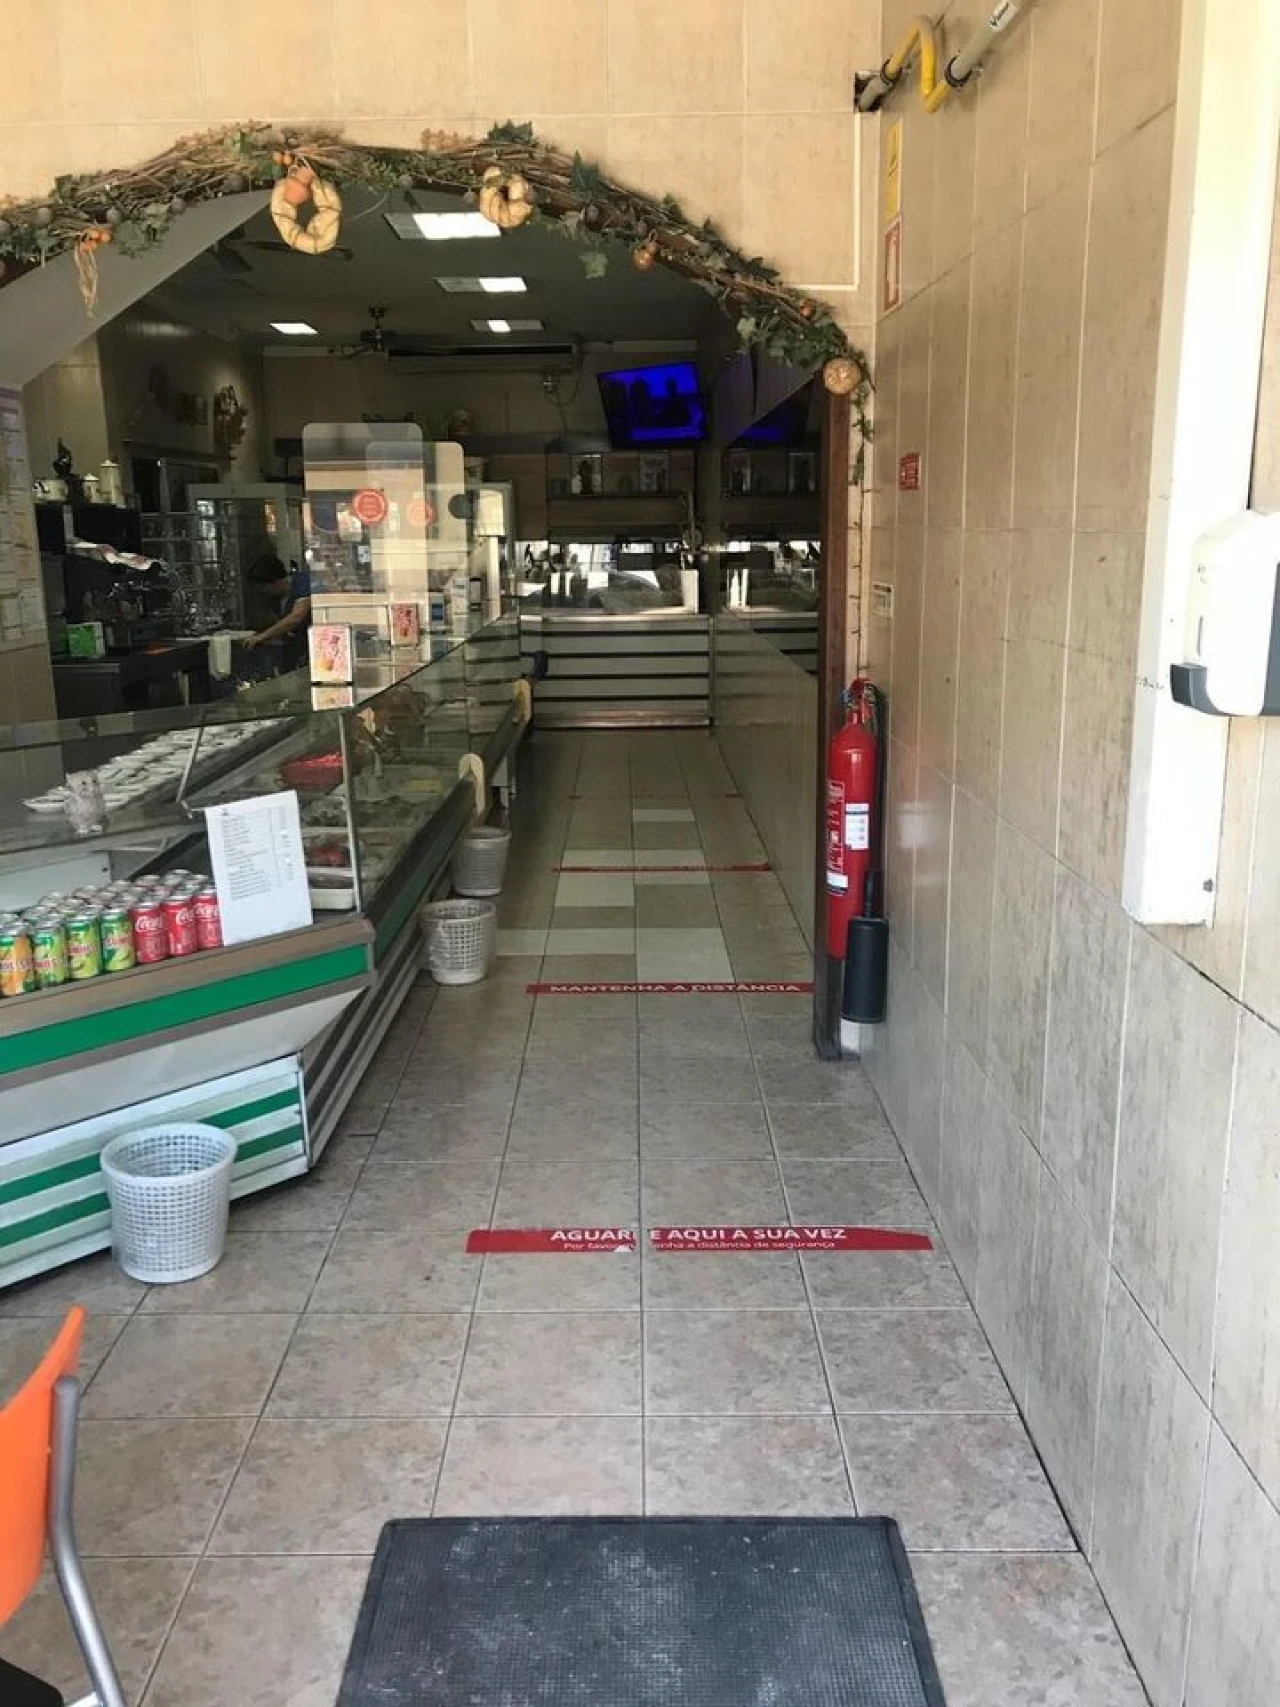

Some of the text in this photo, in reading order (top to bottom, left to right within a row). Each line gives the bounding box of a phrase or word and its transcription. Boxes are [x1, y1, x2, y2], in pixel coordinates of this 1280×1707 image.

[668, 1229, 725, 1241] AQUI
[732, 1229, 747, 1240] A
[753, 1228, 800, 1240] SUA
[803, 1228, 847, 1239] VEZ
[563, 1242, 583, 1250] Por
